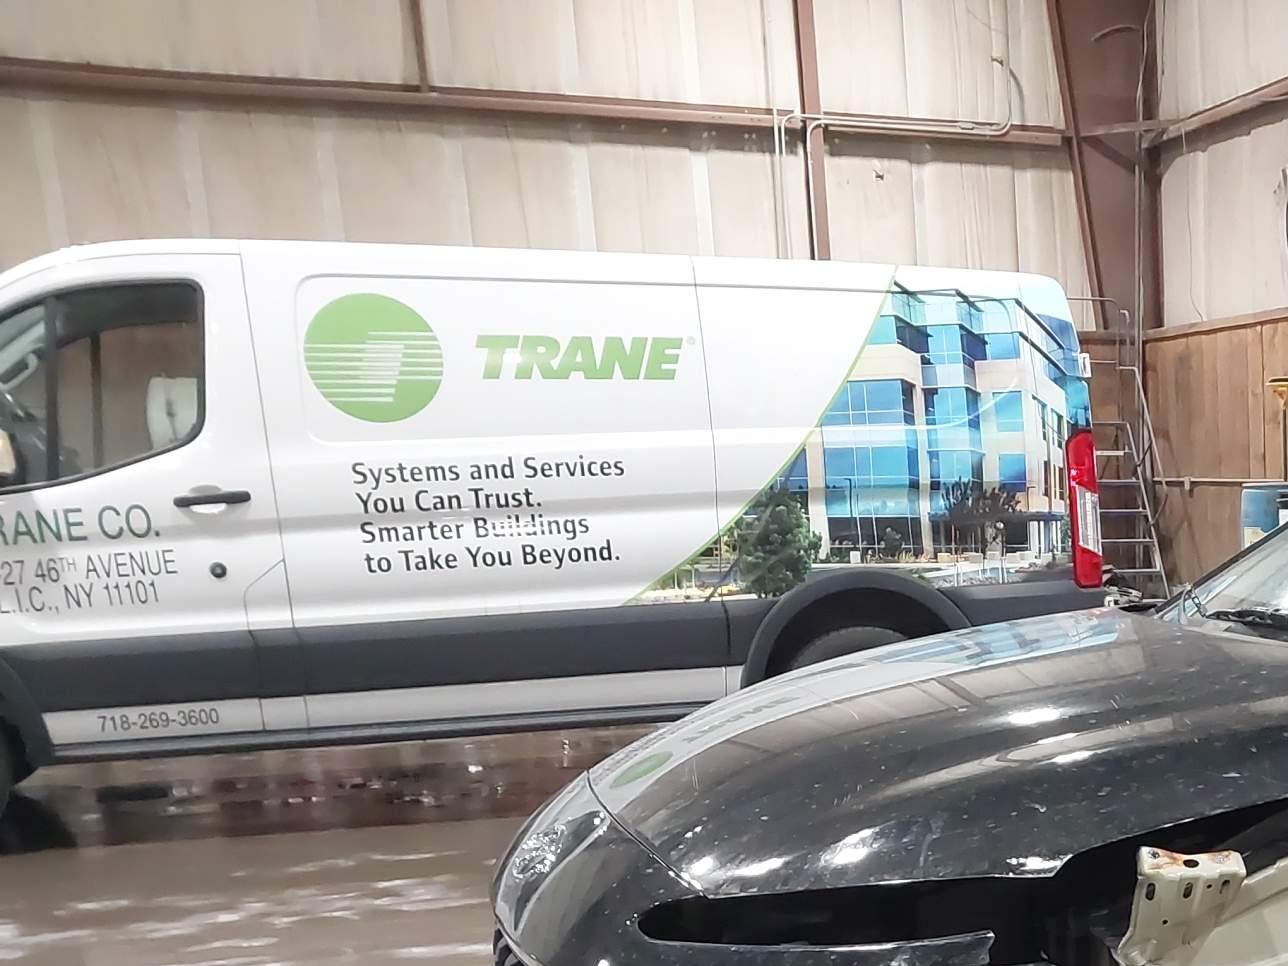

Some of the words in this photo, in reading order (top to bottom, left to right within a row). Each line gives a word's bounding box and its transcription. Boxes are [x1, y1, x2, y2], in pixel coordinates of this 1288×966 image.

[476, 335, 683, 380] TRANE
[352, 462, 461, 490] Systems
[470, 456, 515, 482] and
[523, 454, 625, 479] Services
[356, 491, 405, 515] You
[415, 489, 463, 512] Can
[467, 487, 543, 511] Trust.
[98, 503, 161, 540] CO.
[360, 520, 465, 544] Smarter
[474, 513, 589, 541] Buildings
[86, 549, 178, 580] AVENUE
[365, 552, 392, 574] to
[398, 547, 458, 573] Take
[465, 545, 512, 568] You
[521, 539, 621, 570] Beyond.
[63, 582, 95, 609] NY
[104, 579, 160, 607] 11101
[97, 707, 220, 733] 718-269-3600
